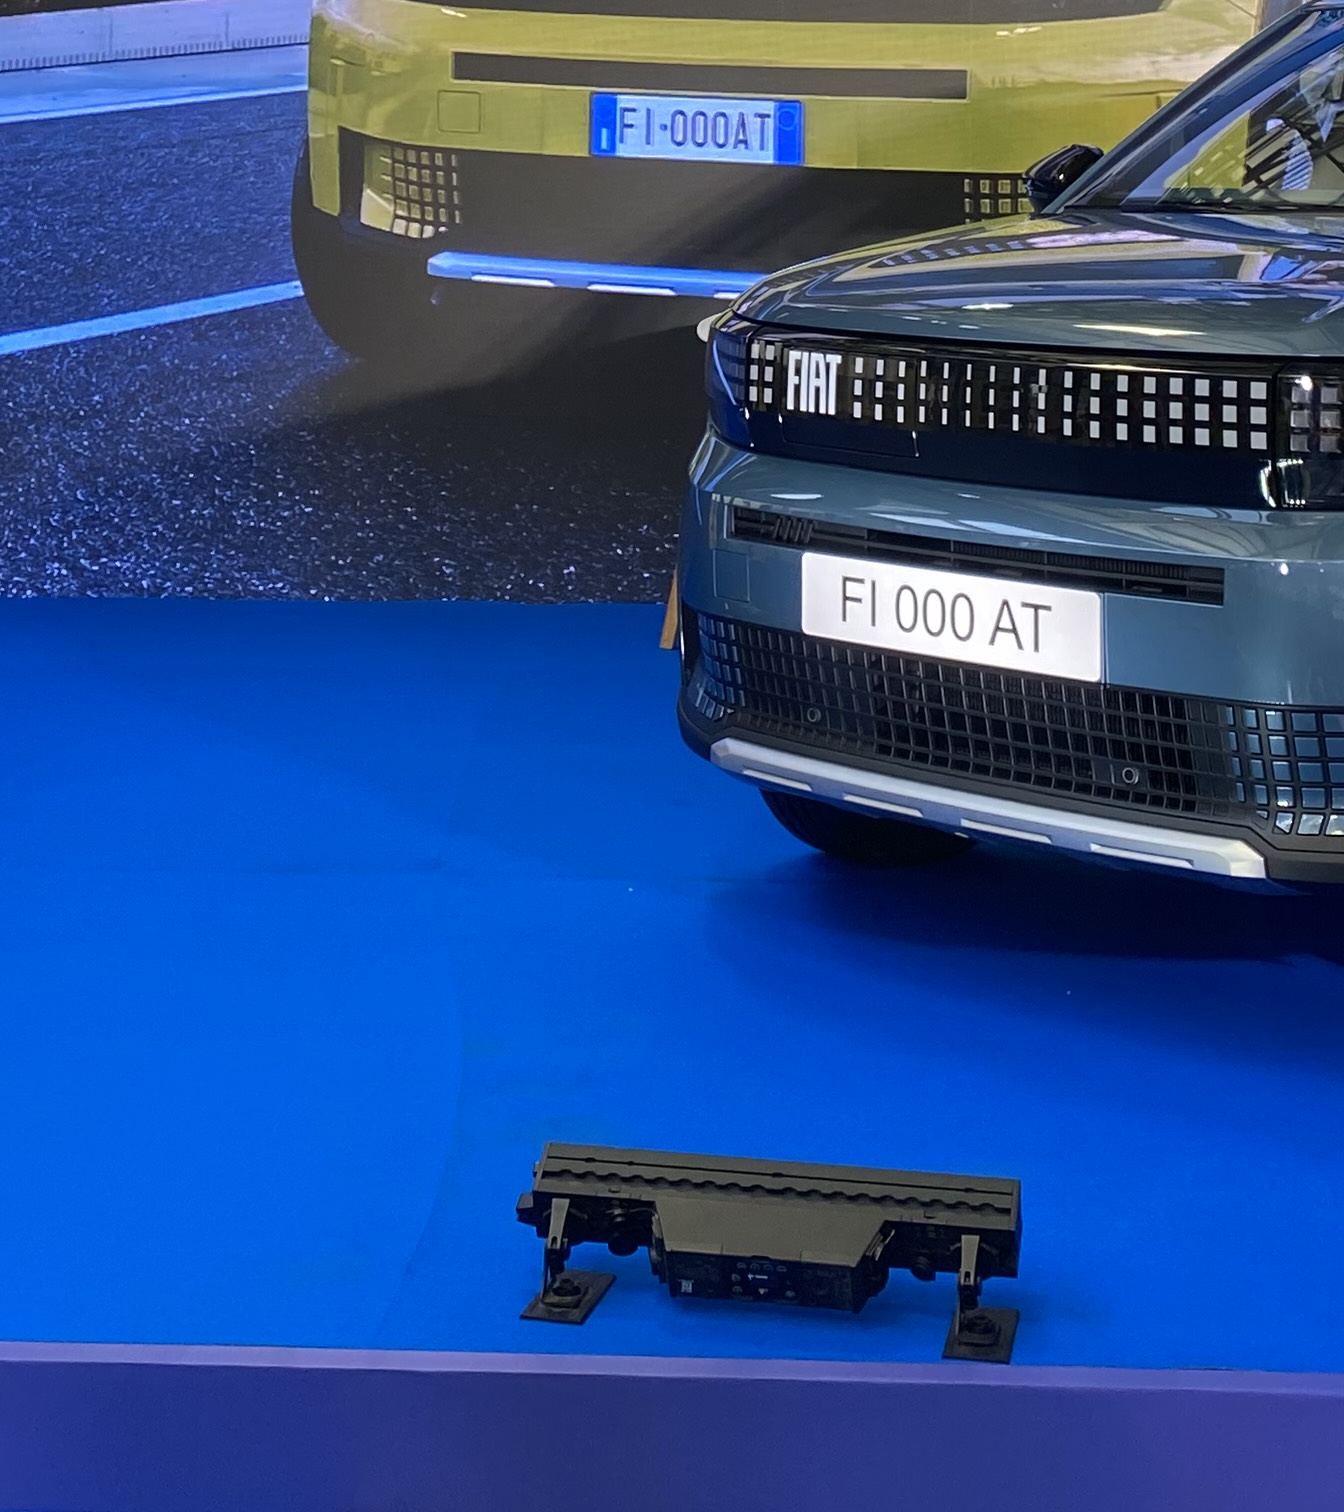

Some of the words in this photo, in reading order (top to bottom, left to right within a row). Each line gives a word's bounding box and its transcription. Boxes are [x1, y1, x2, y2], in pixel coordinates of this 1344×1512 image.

[787, 350, 842, 415] FIAT
[841, 575, 877, 627] FI
[895, 584, 975, 642] 000
[988, 598, 1052, 653] AT
